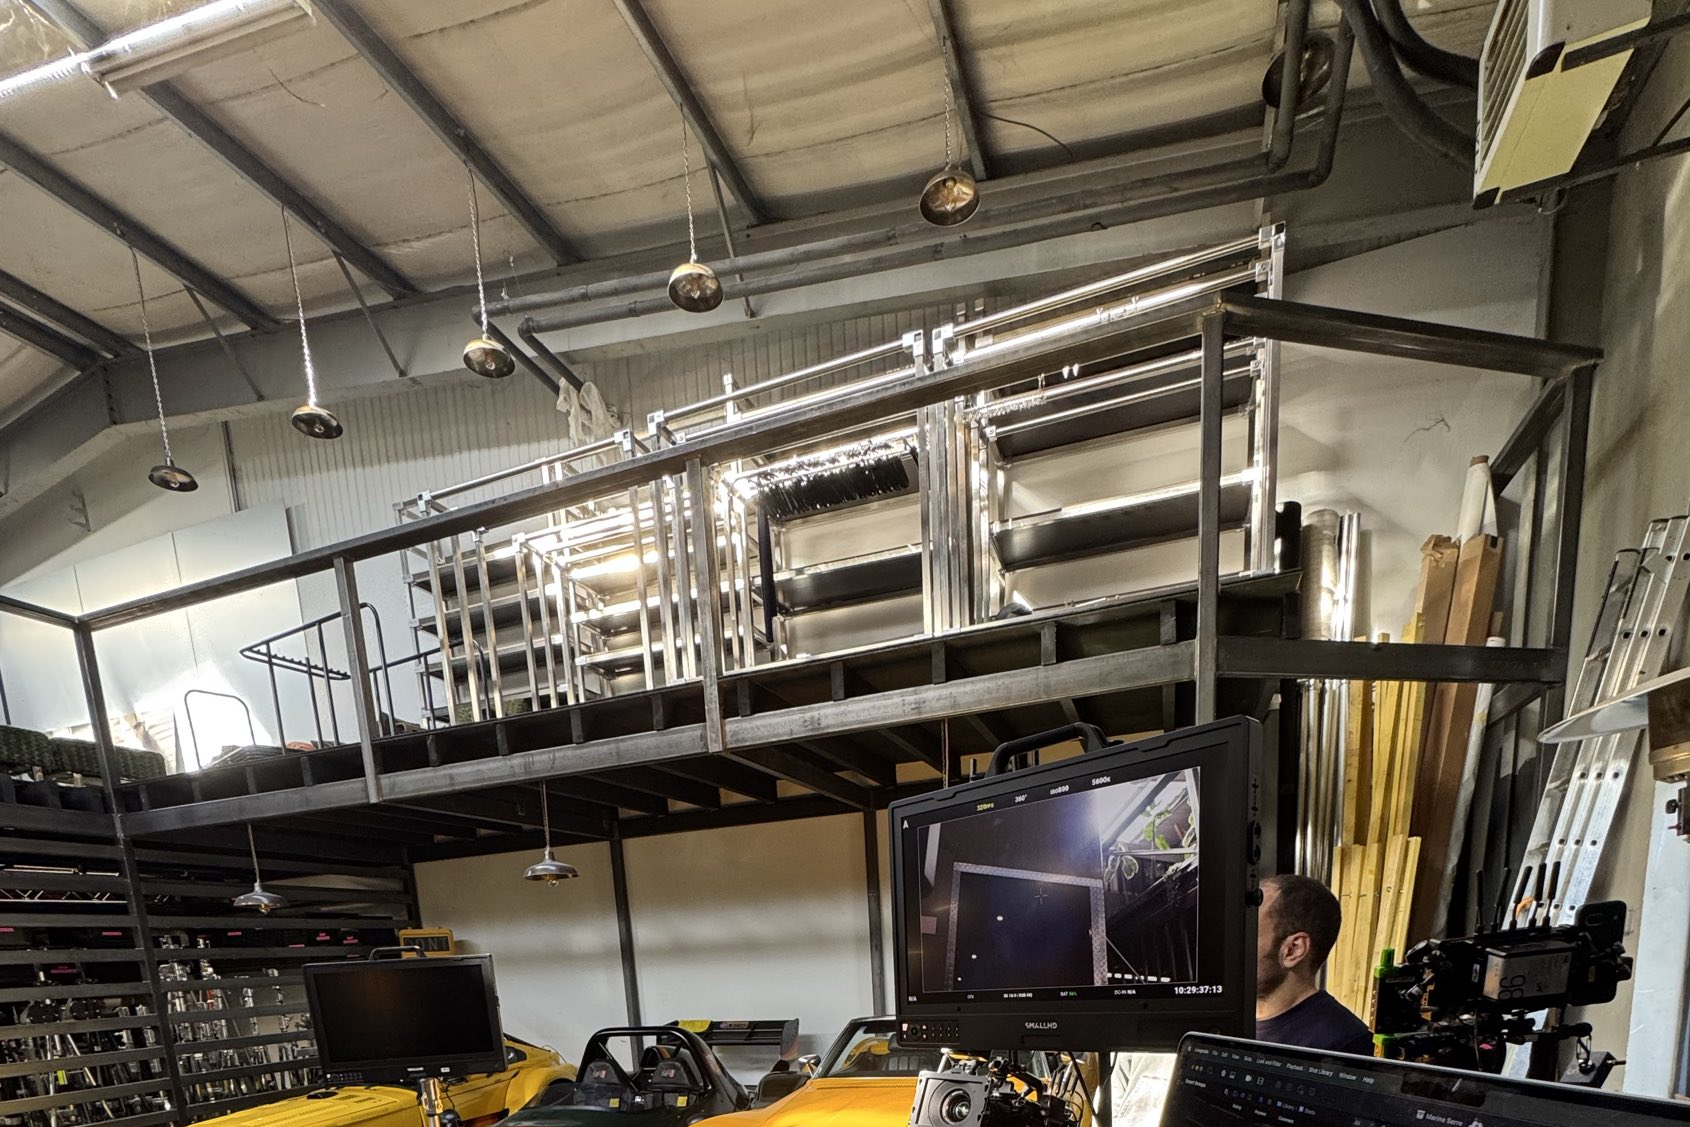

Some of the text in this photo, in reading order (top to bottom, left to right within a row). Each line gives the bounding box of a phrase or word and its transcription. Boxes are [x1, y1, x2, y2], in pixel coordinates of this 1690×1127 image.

[903, 820, 908, 829] A
[1175, 985, 1222, 994] 10:29:37:13
[1286, 1063, 1303, 1071] Playback
[1319, 1069, 1333, 1077] Library
